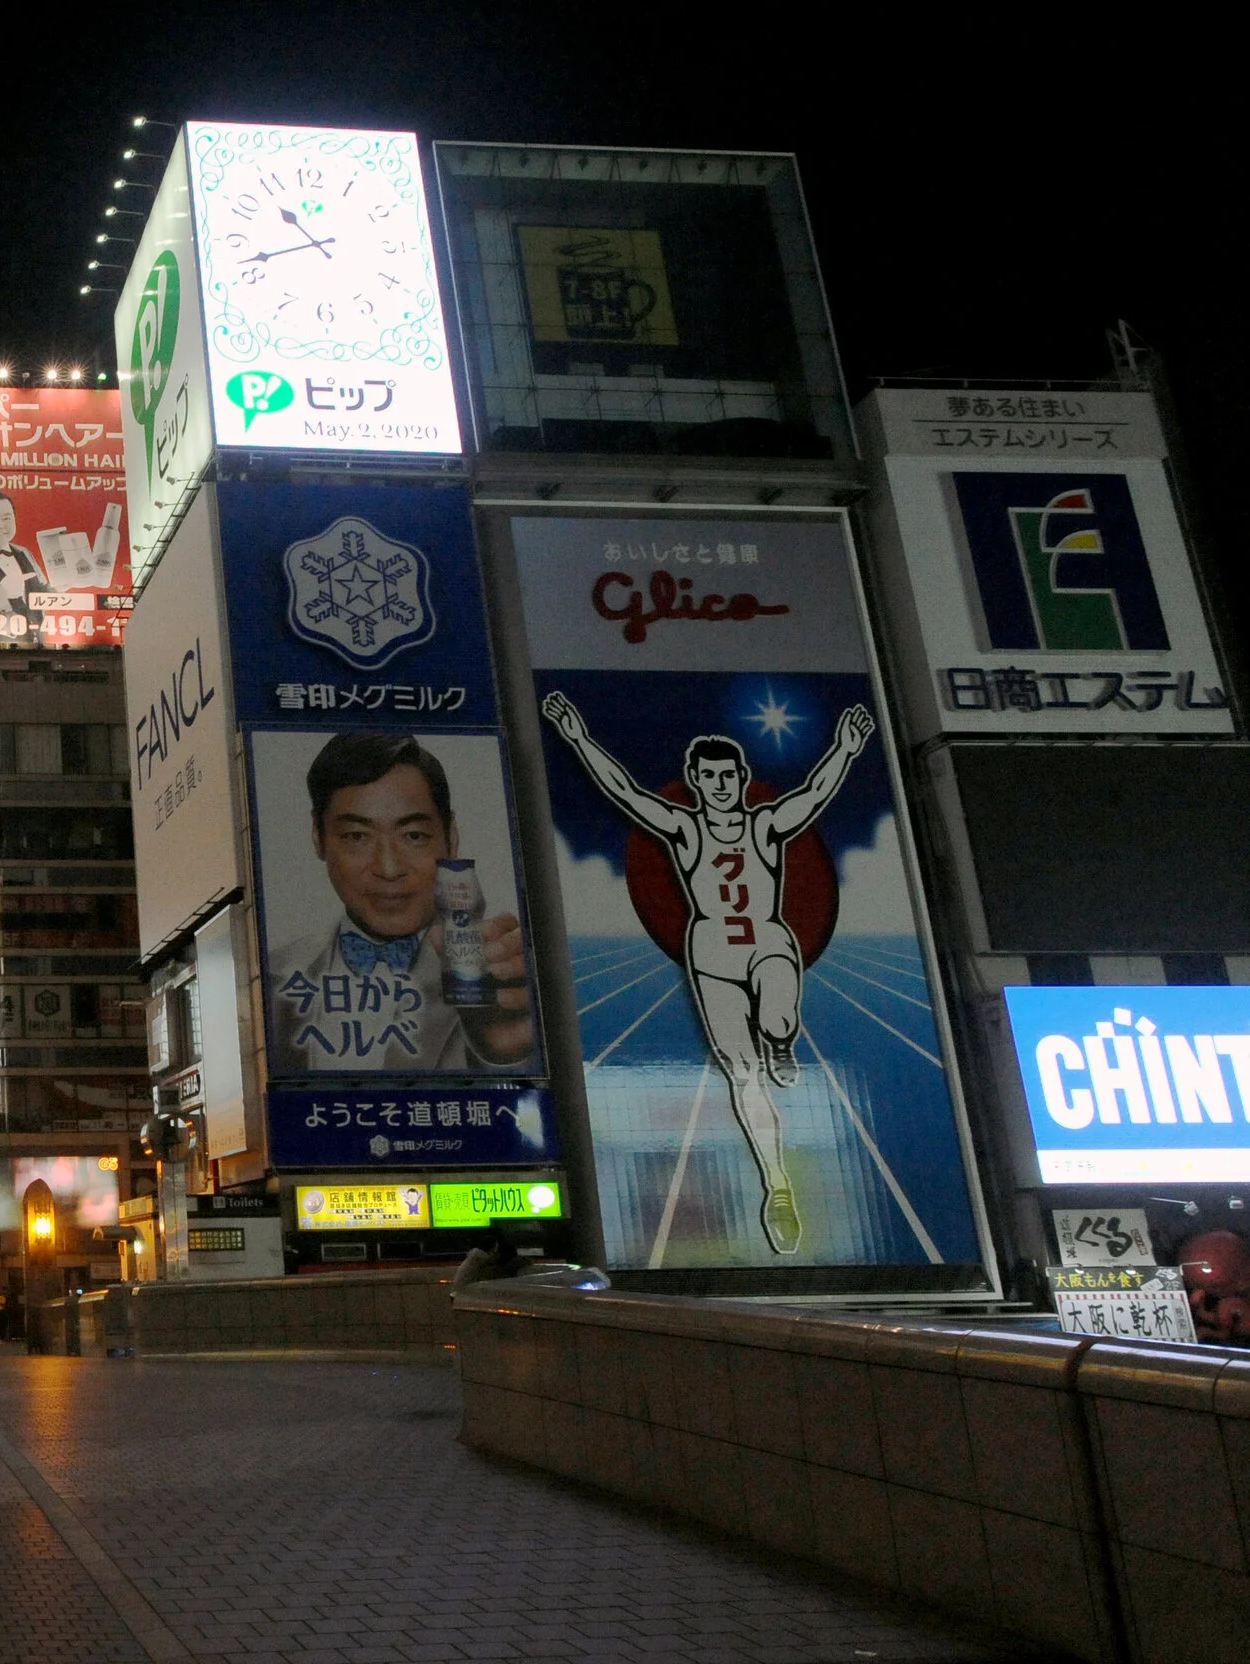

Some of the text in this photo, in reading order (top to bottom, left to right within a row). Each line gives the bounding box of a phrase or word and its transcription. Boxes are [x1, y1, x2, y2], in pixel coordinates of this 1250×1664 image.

[259, 172, 286, 196] 11
[295, 168, 323, 189] 12
[342, 180, 354, 197] 1
[231, 193, 261, 221] 10
[225, 233, 250, 248] 9
[241, 267, 266, 285] 8
[377, 271, 400, 290] 4
[277, 291, 299, 311] 7
[316, 302, 335, 323] 6
[305, 376, 397, 412] ピップ
[946, 396, 1085, 418] 夢ある住まい
[156, 373, 189, 480] ピップ
[380, 423, 439, 440] 2020
[931, 428, 1118, 449] エステムシリーズ
[1, 451, 78, 467] MILLION
[603, 541, 759, 565] おいしさと健康
[34, 595, 72, 608] ルアン
[592, 570, 790, 643] Glico
[275, 682, 467, 712] 雪印メグミルク
[944, 666, 1230, 710] 日商エステム
[136, 636, 215, 791] FANCL
[711, 847, 757, 946] グリコ
[279, 969, 424, 1014] 今日から
[296, 1020, 419, 1058] ヘルベ
[305, 1100, 519, 1128] ようこそ道頓堀へ
[393, 1138, 463, 1152] 雪印メグミルク
[228, 1197, 264, 1208] Toilets
[330, 1192, 397, 1203] 店舗情報館
[472, 1188, 525, 1213] ピタットハウス
[1074, 1216, 1133, 1257] くくる
